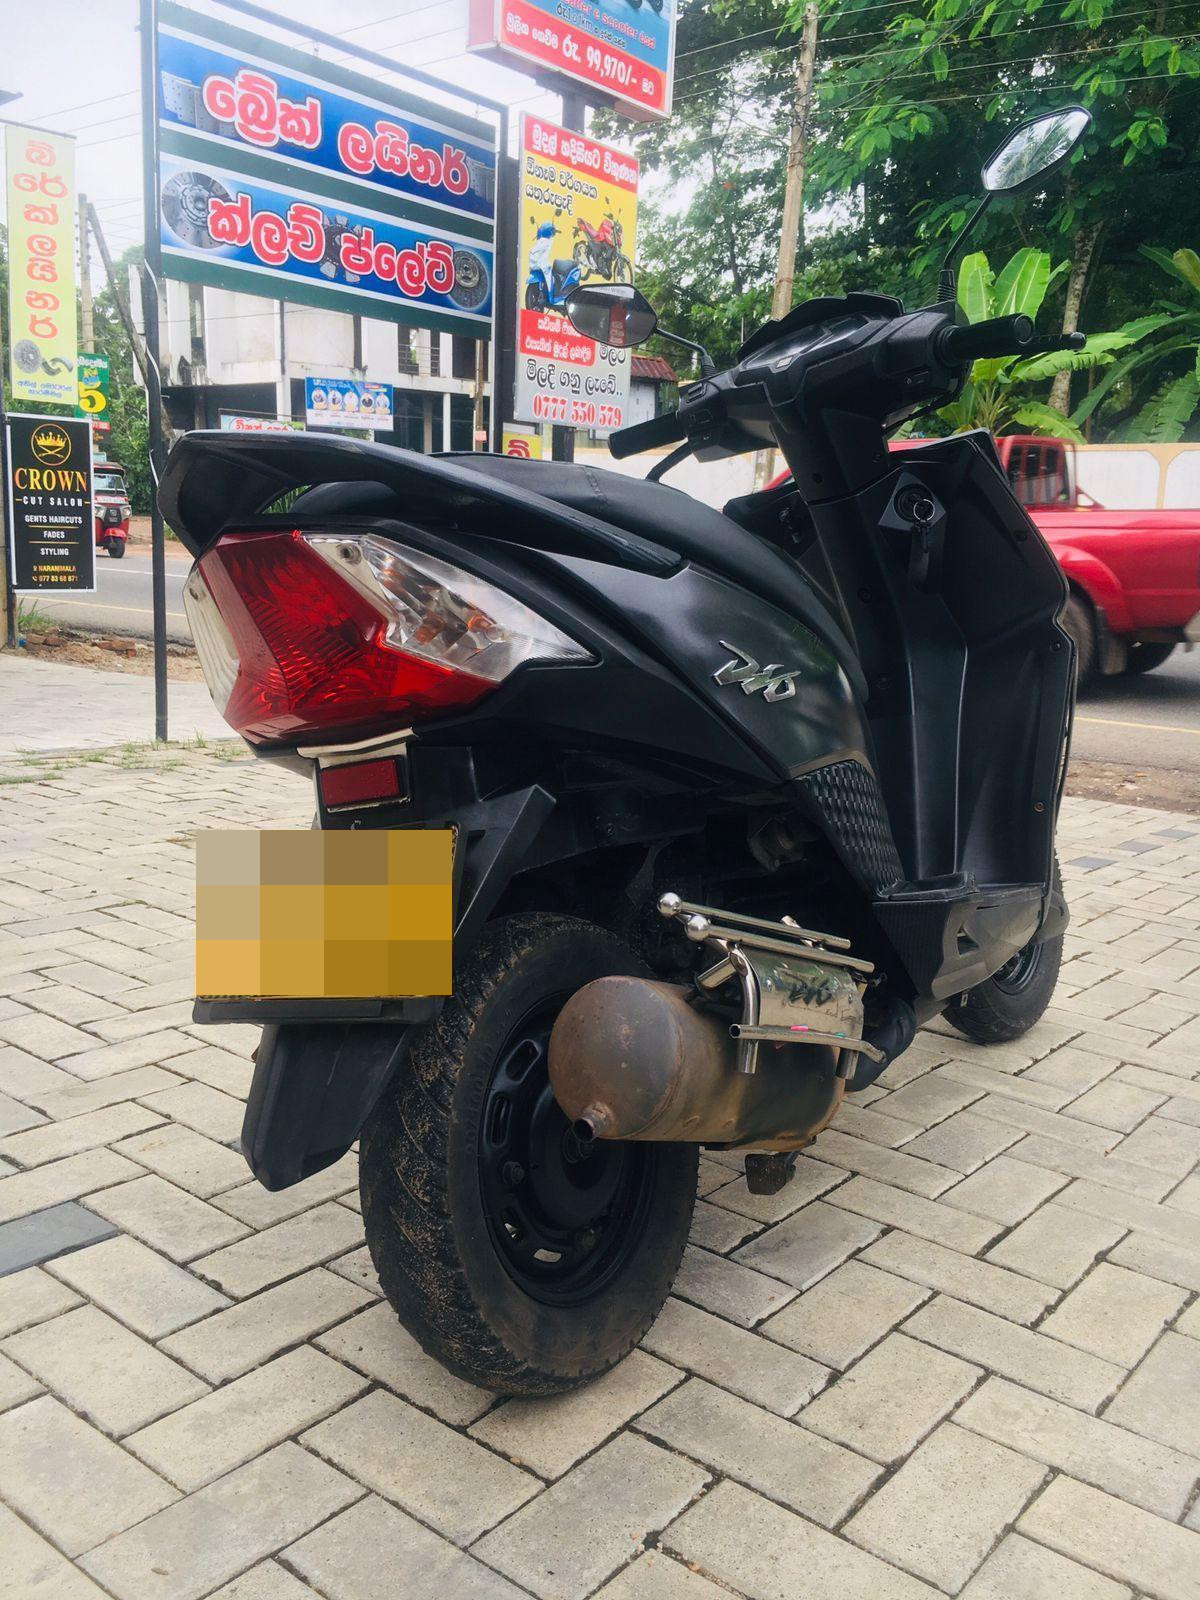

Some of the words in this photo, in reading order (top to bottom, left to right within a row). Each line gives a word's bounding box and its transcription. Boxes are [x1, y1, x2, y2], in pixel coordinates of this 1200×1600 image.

[586, 45, 638, 86] 99,970/-
[532, 123, 558, 157] මුදල්
[526, 358, 556, 390] මිලදී
[560, 371, 581, 395] ගනු
[79, 381, 107, 413] 5
[533, 394, 567, 420] 0777
[599, 404, 623, 428] 579
[14, 467, 87, 492] CROWN
[23, 496, 43, 505] CUT
[49, 497, 83, 507] SALON
[24, 515, 47, 523] GENTS
[49, 515, 83, 524] HAIRCUTS
[43, 531, 65, 539] FADES
[40, 548, 69, 556] STYLING
